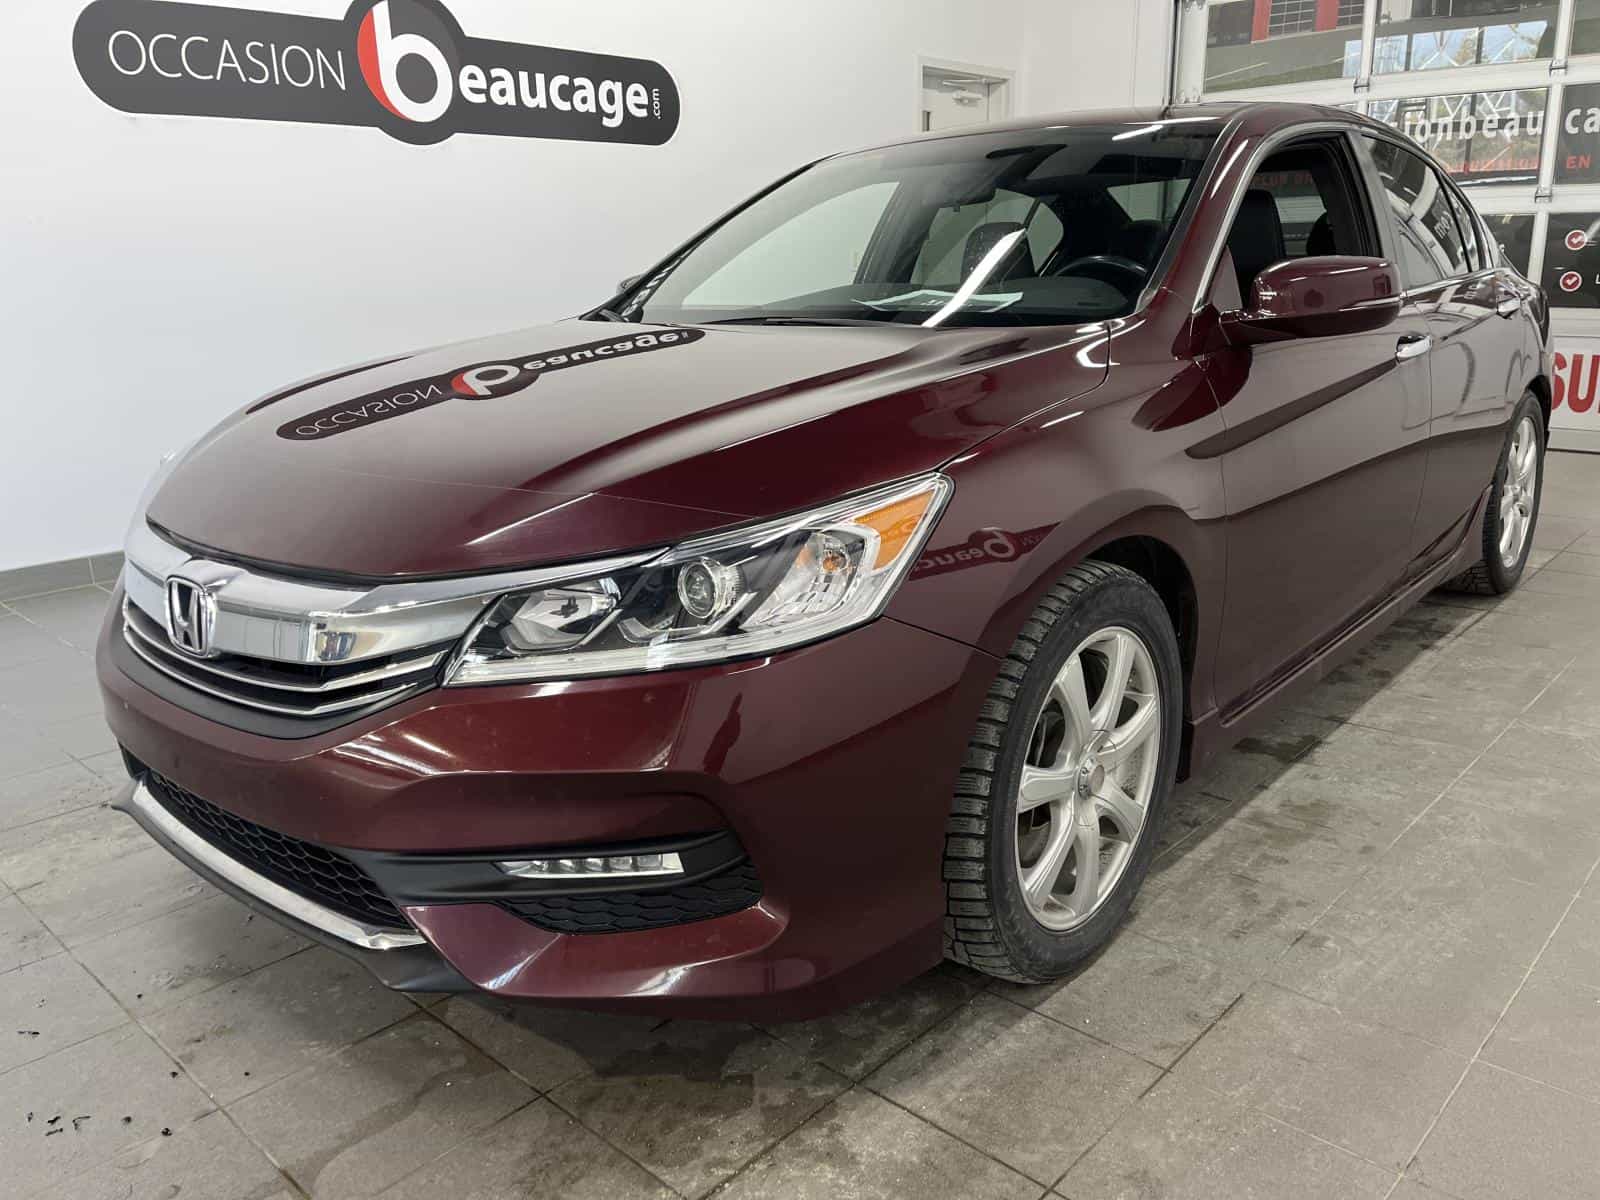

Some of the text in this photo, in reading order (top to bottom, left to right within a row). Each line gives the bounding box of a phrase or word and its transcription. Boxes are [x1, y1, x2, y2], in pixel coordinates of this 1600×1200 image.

[107, 29, 347, 91] OCCASION
[1566, 155, 1591, 169] EN
[1552, 352, 1600, 414] SU
